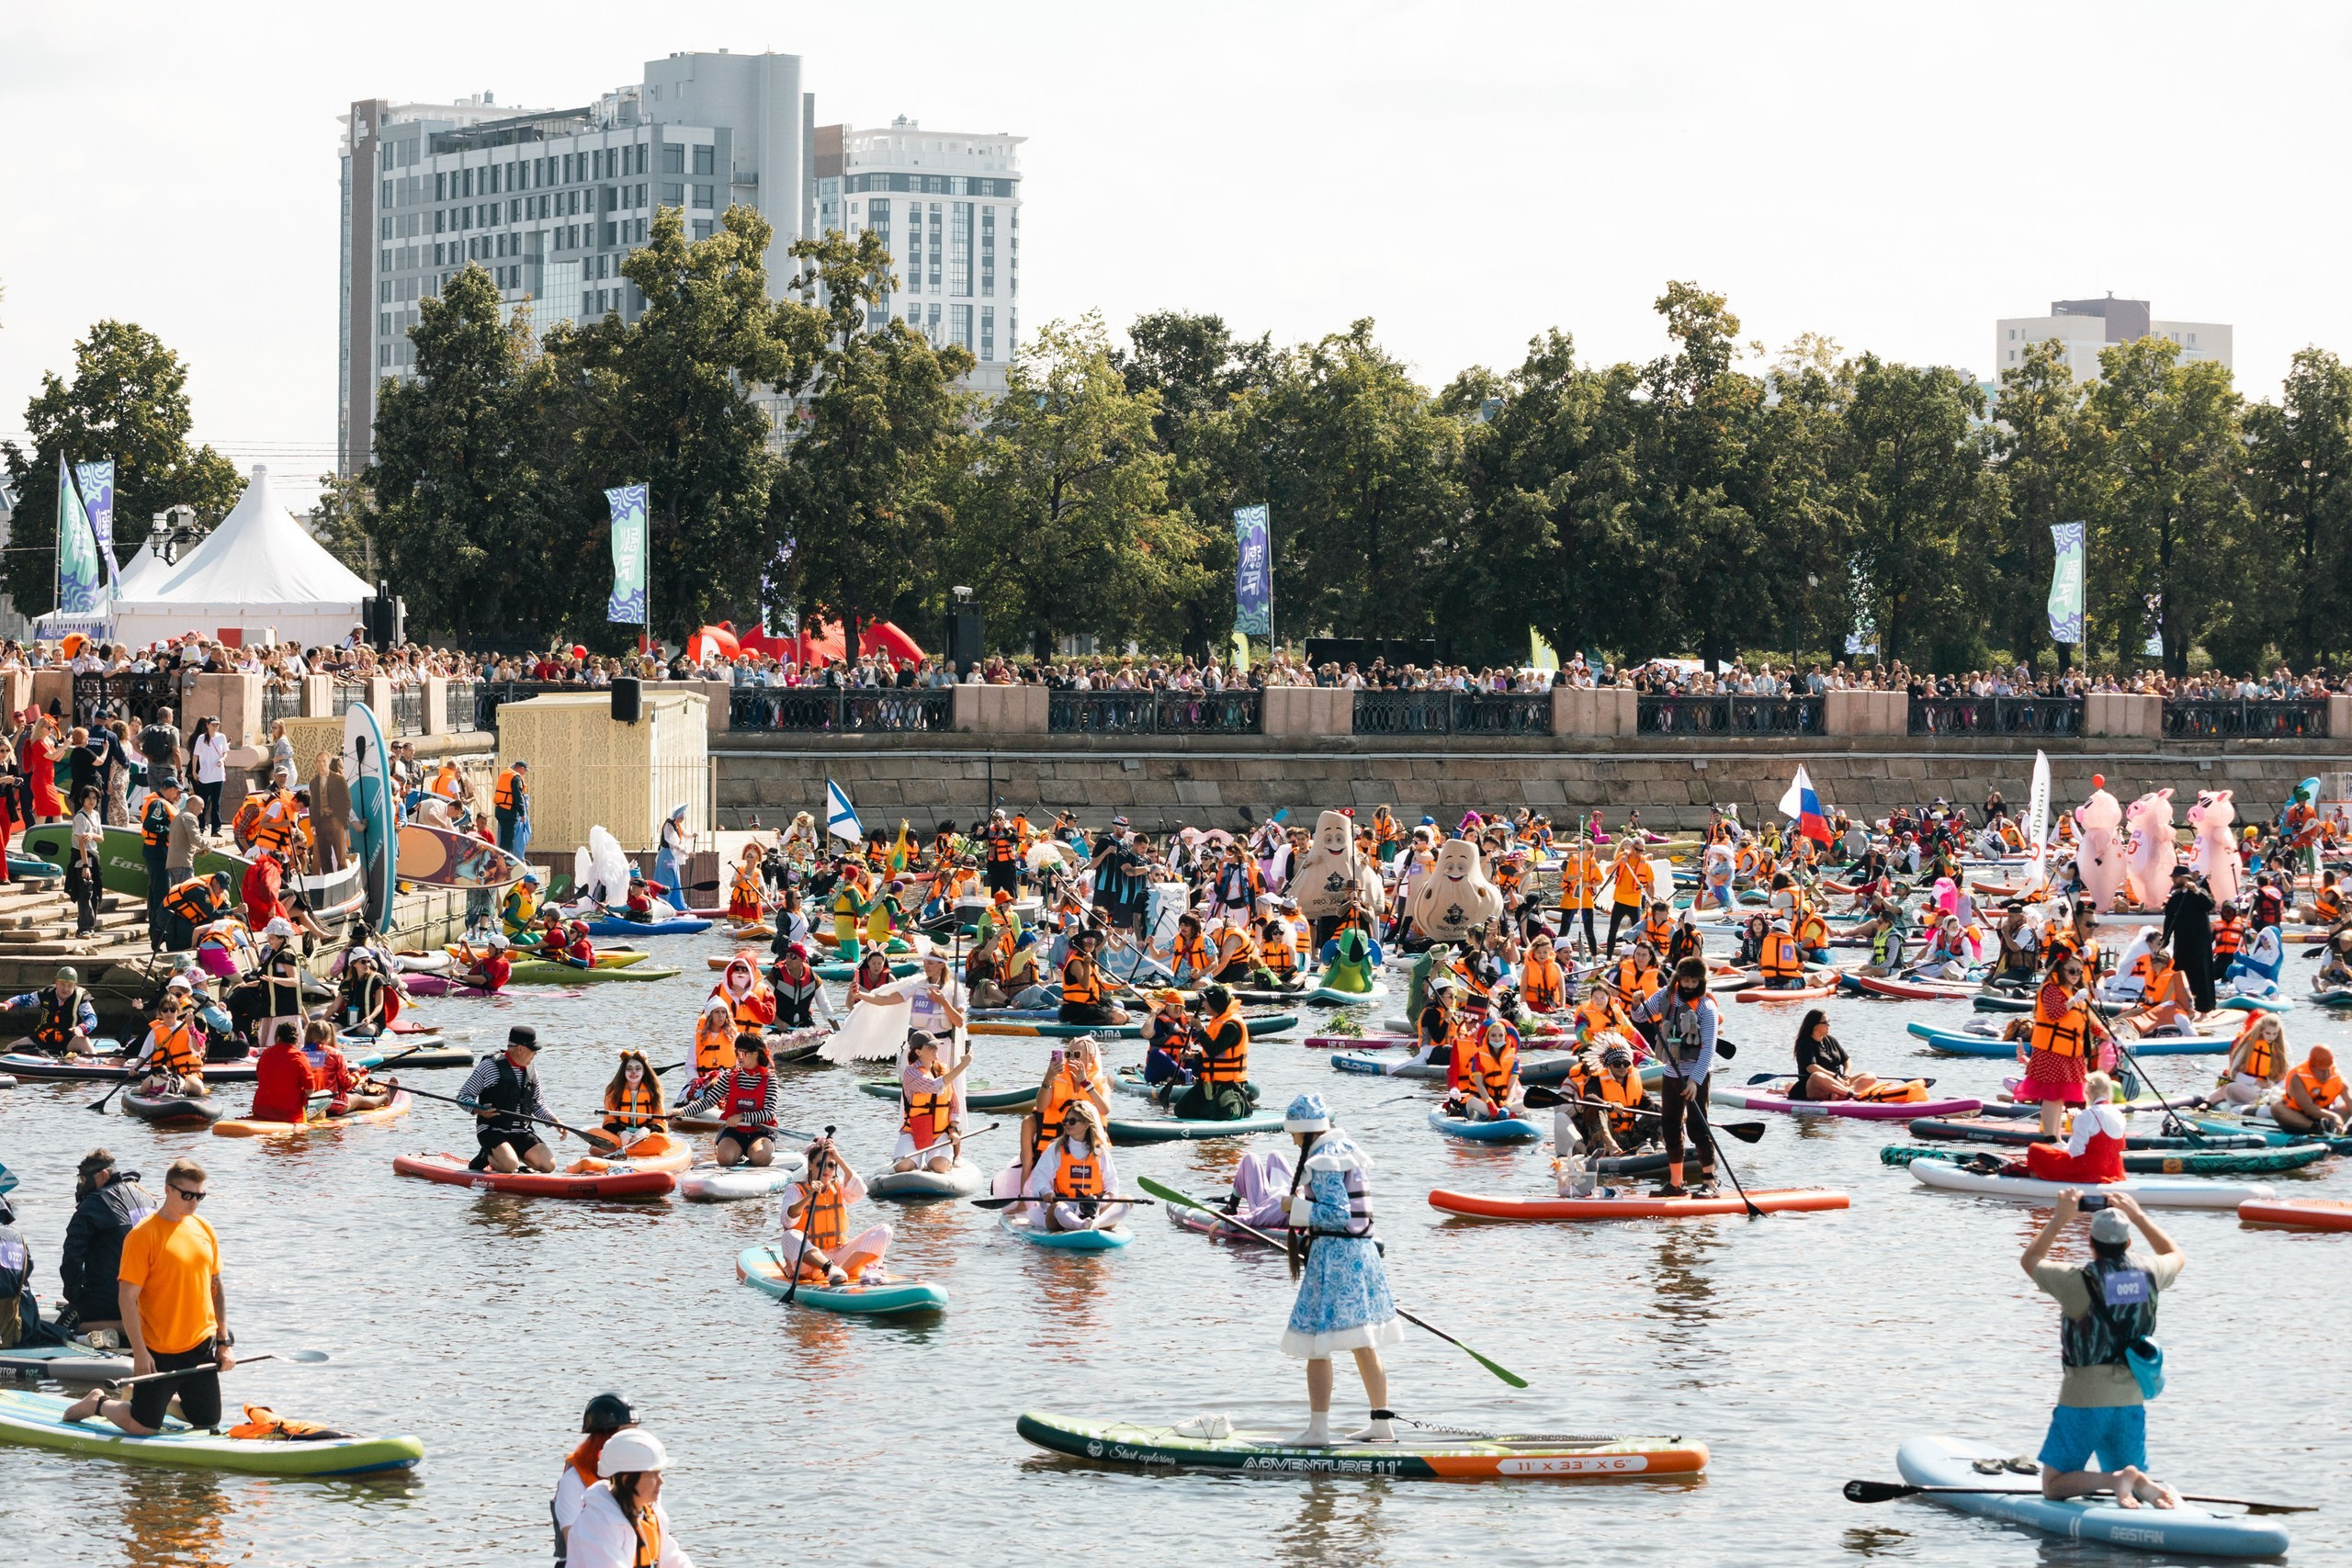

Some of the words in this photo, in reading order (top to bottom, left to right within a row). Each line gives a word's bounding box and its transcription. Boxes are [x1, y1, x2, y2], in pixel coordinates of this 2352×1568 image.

[368, 838, 383, 871] JOURNEY
[1089, 1030, 1122, 1038] DAMA
[2117, 1282, 2140, 1296] 0092
[1109, 1445, 1137, 1461] Start
[1138, 1452, 1176, 1465] exploring
[1242, 1456, 1373, 1472] ADVENTURE
[1518, 1461, 1535, 1471] 11'
[1559, 1461, 1590, 1470] 33"
[1613, 1460, 1632, 1469] 6"
